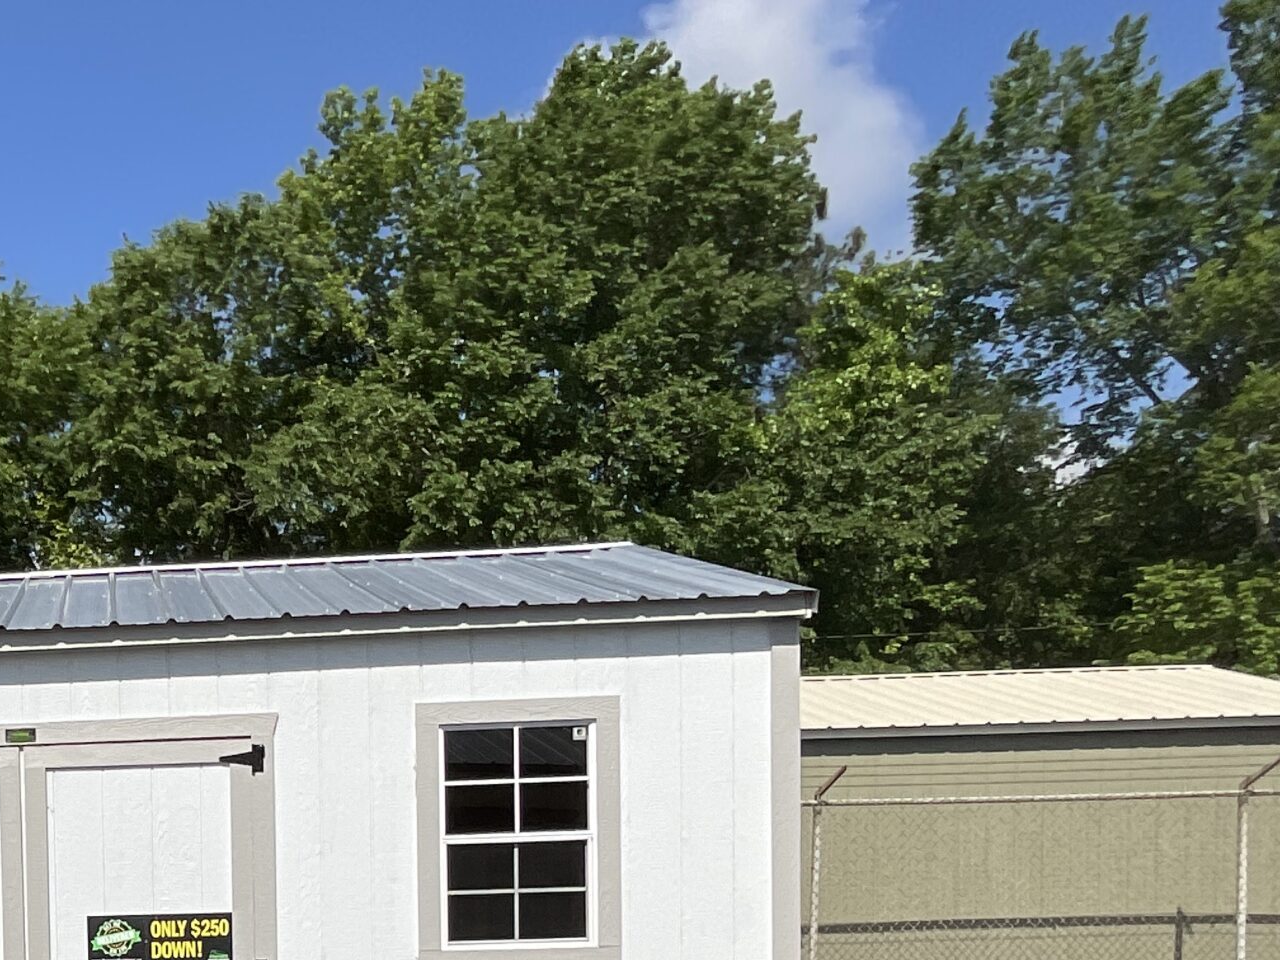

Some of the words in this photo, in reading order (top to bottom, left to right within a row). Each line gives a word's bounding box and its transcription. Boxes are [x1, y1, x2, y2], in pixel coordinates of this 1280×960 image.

[150, 919, 187, 938] ONLY
[191, 918, 229, 938] $250
[151, 940, 203, 959] DOWN!
